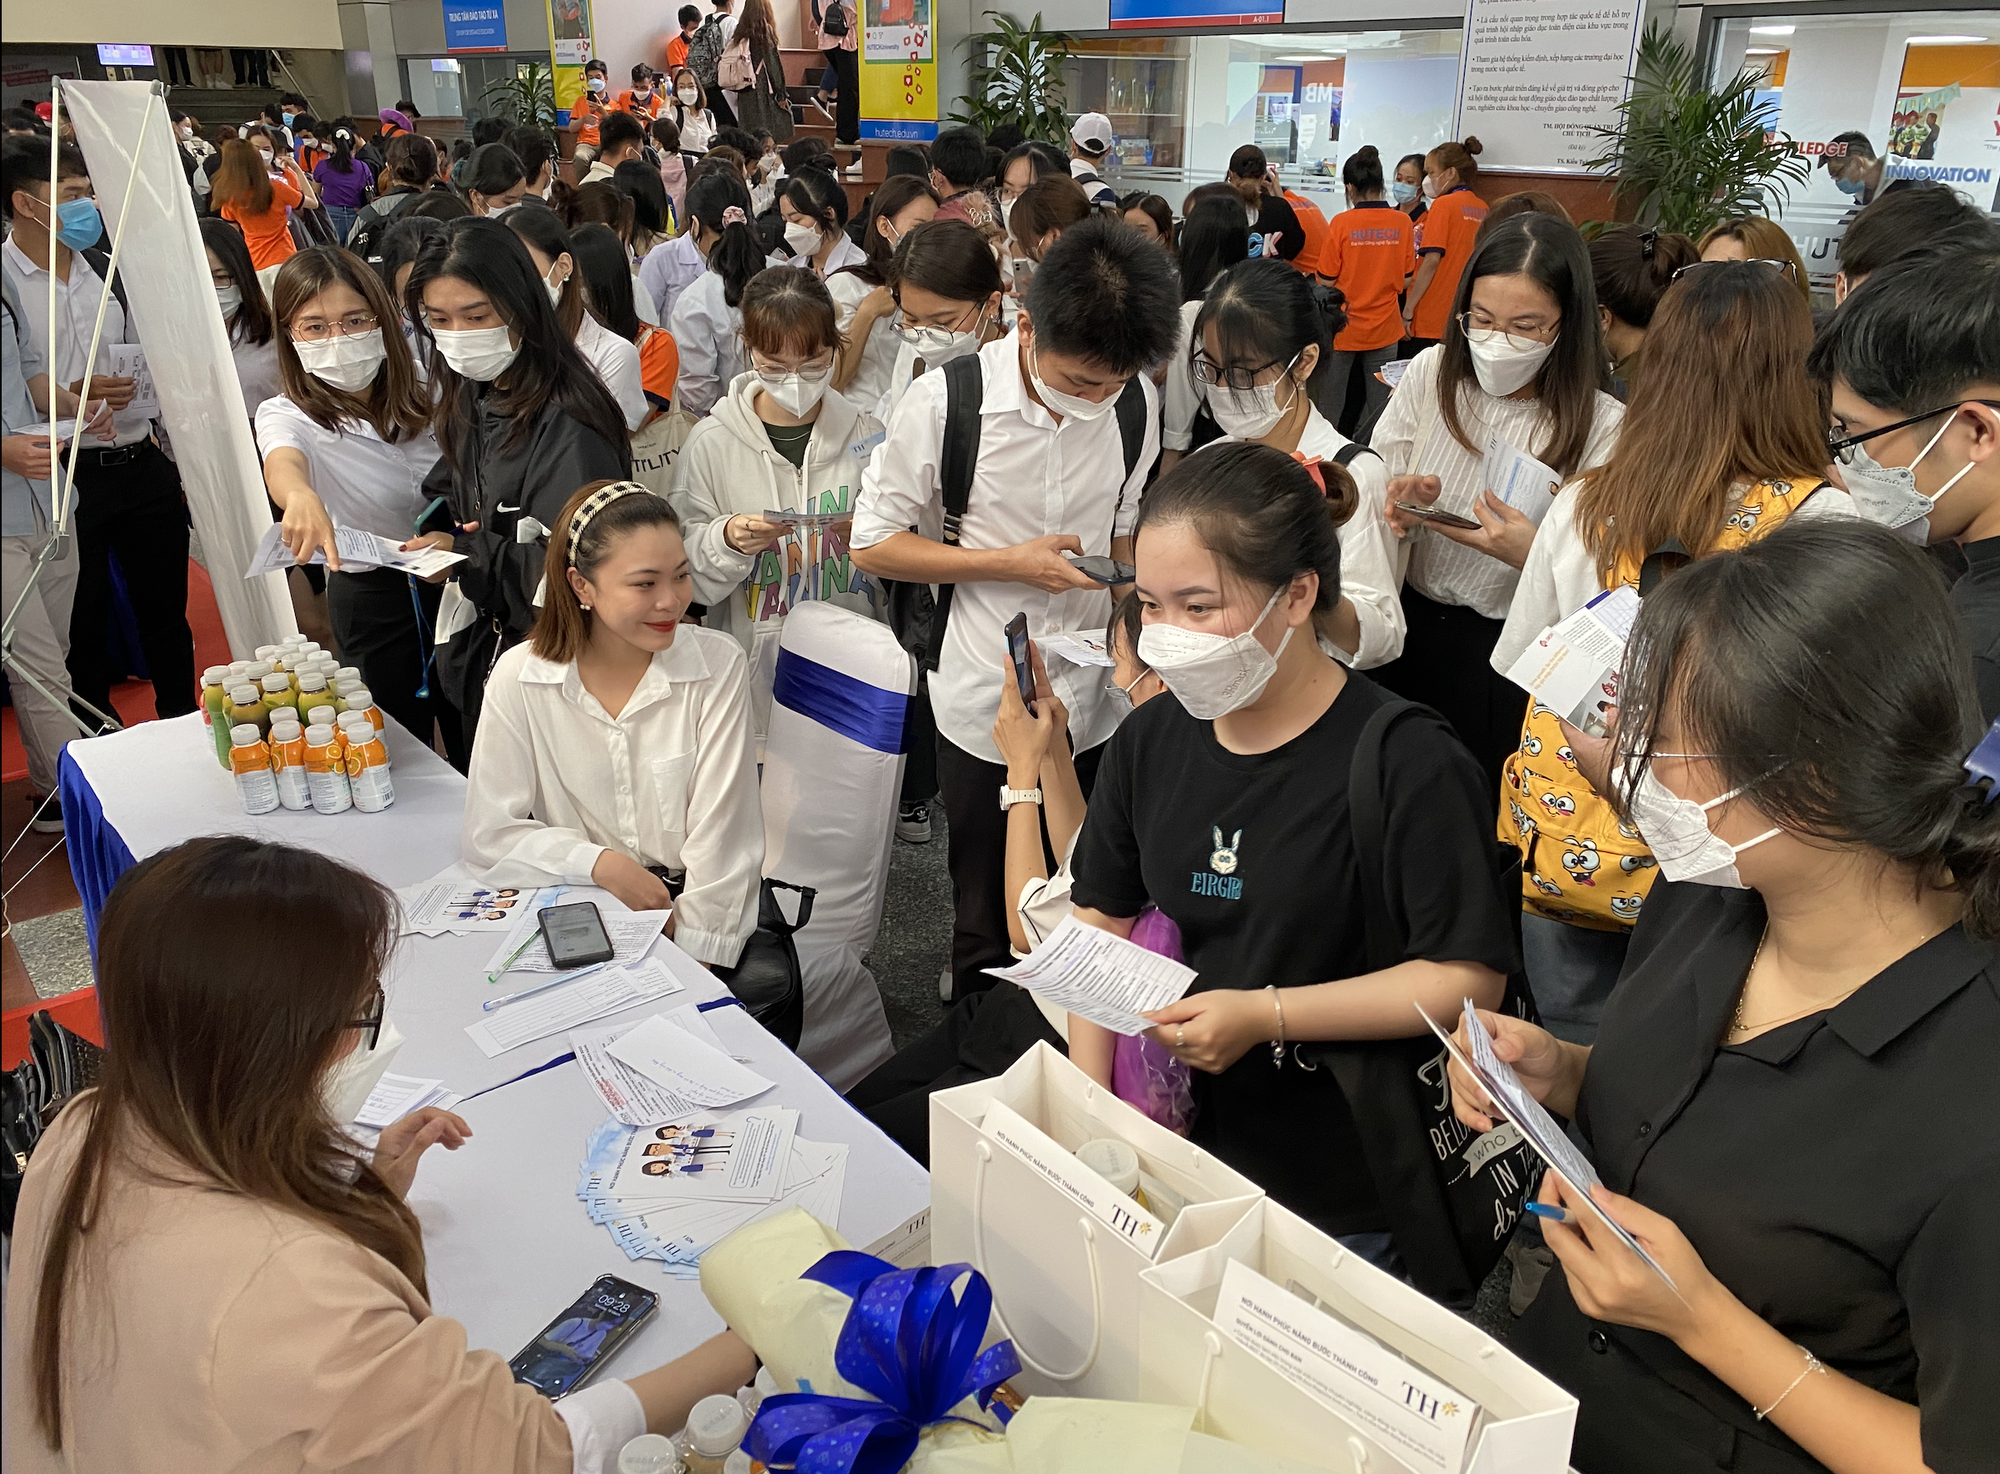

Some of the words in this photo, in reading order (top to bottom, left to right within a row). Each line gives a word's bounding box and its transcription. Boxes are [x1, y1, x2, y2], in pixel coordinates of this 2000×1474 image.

[1253, 15, 1270, 23] A-01.1
[875, 127, 918, 138] hutech.edu.vn
[1885, 165, 1992, 183] INNOVATION
[1350, 228, 1400, 240] HUTECH
[1793, 236, 1839, 260] HUT
[630, 446, 680, 472] TILITY
[1473, 1134, 1507, 1161] who
[586, 1178, 602, 1191] TH
[1018, 1147, 1034, 1161] PHÚC
[1060, 1179, 1081, 1196] THÀNH
[1078, 1192, 1096, 1208] CÔNG
[906, 1215, 925, 1234] TH
[1110, 1204, 1139, 1239] TH
[618, 1224, 632, 1239] TH
[663, 1242, 681, 1257] TH
[598, 1294, 630, 1313] 09:28
[1270, 1316, 1292, 1333] PHÚC
[1310, 1340, 1333, 1358] BƯỚC
[1331, 1353, 1360, 1374] THÀNH
[1356, 1368, 1379, 1386] CÔNG
[1402, 1381, 1440, 1422] TH
